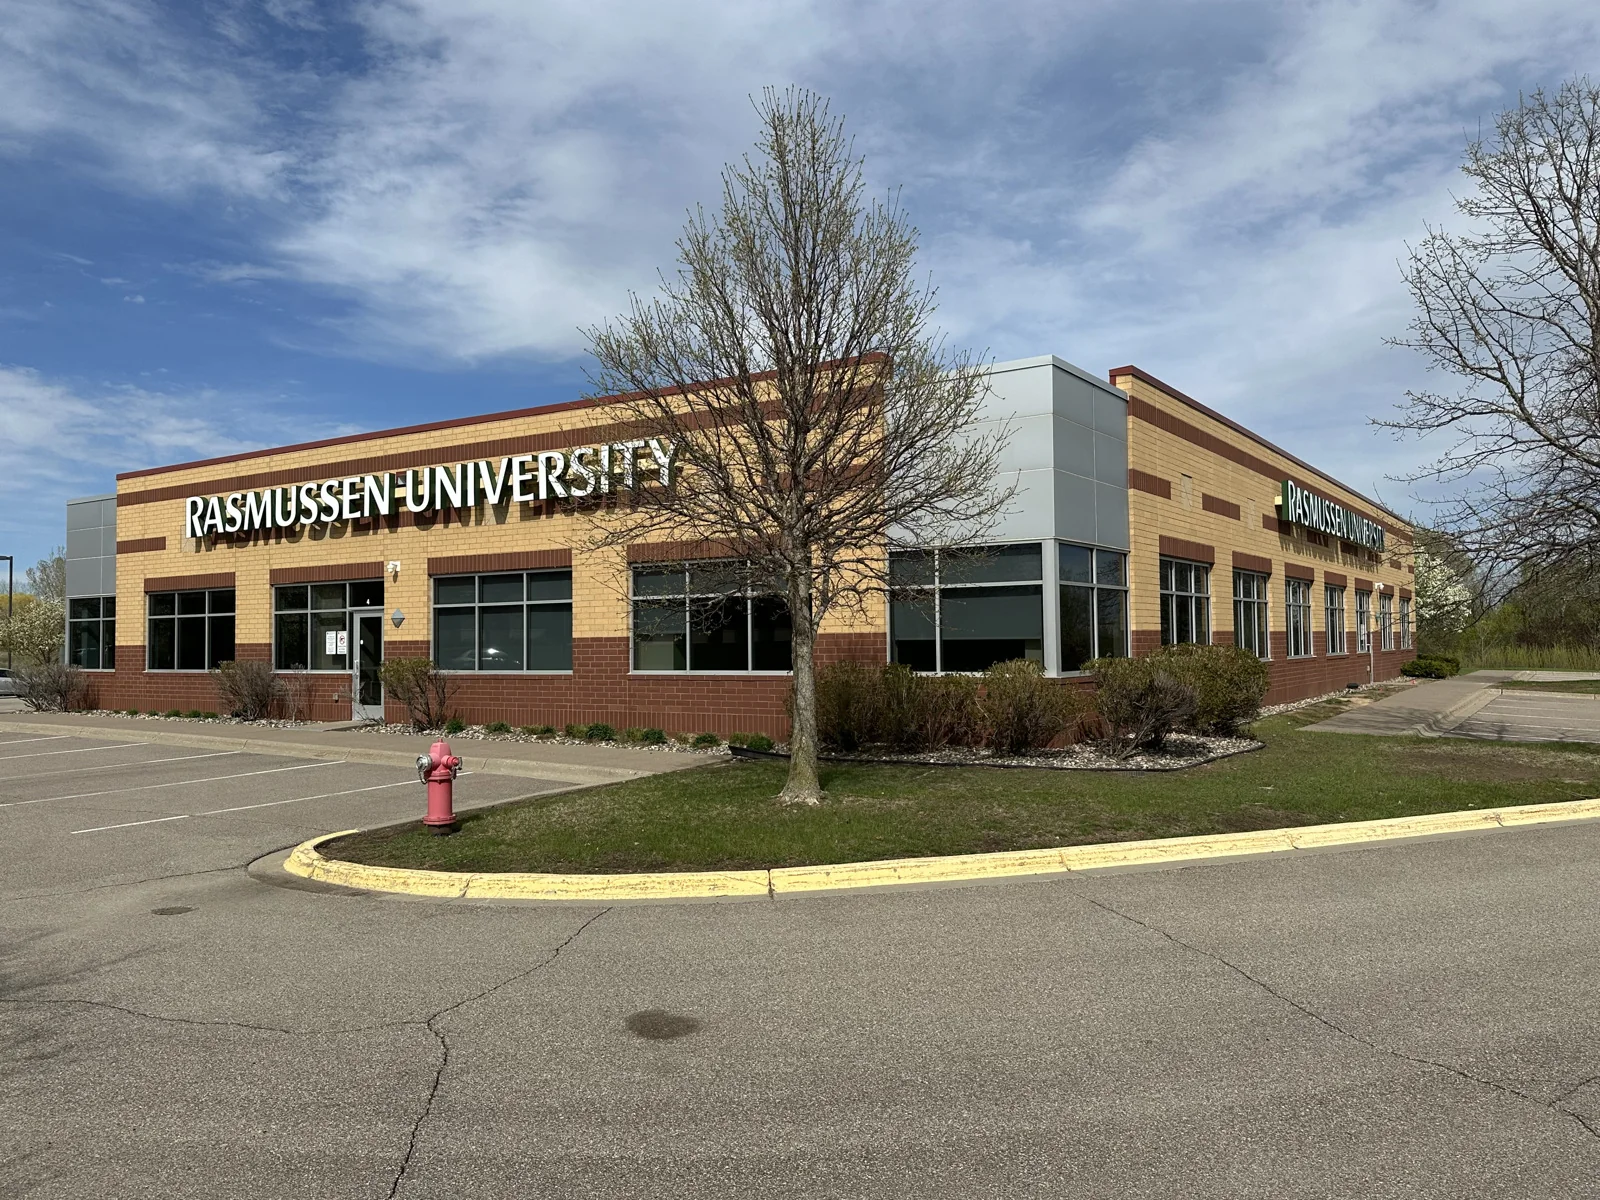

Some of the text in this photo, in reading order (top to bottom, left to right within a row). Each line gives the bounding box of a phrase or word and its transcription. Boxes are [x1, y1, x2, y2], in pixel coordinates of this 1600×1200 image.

[185, 438, 679, 538] RASMUSSEN UNIVERSITY
[1287, 480, 1347, 539] RASMUSSEN
